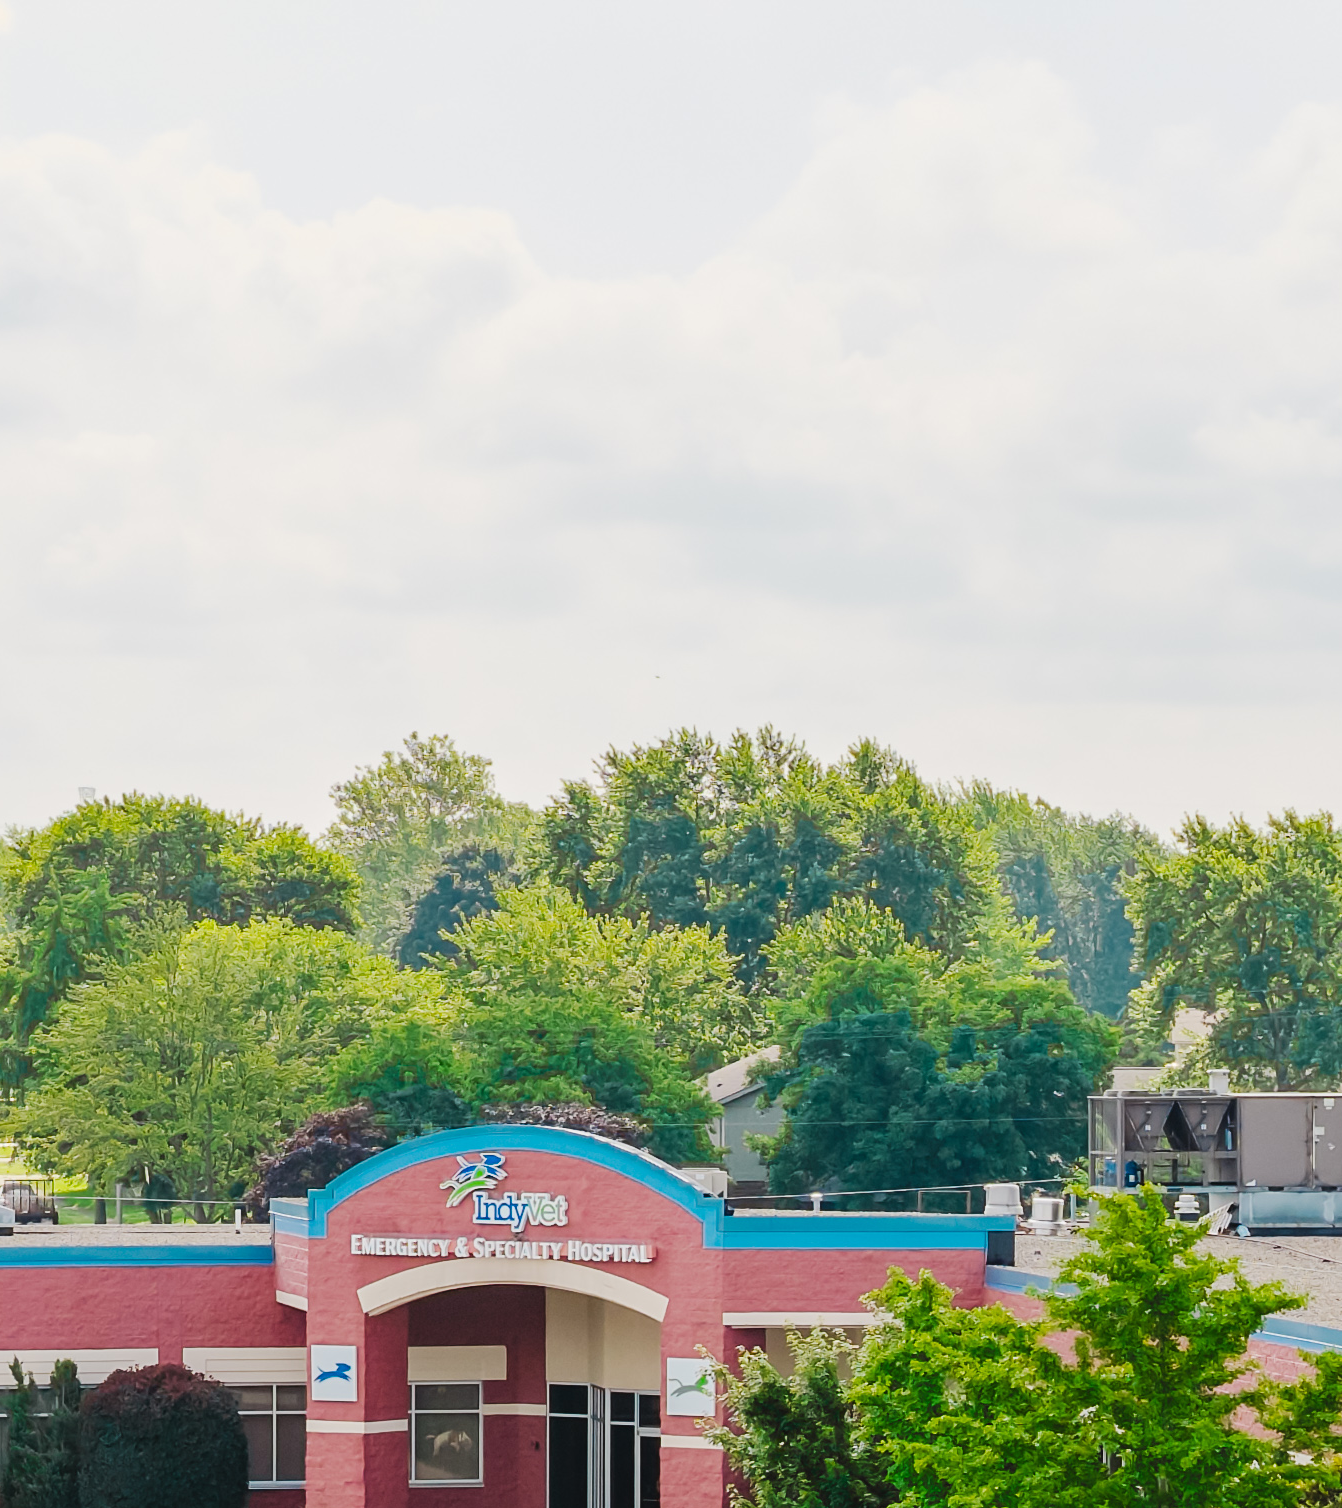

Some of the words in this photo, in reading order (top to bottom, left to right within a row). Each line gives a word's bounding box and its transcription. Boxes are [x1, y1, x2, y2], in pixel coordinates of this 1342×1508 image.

[474, 1193, 567, 1230] IndyVet
[351, 1234, 451, 1257] EMERGENCY
[455, 1237, 469, 1258] &
[473, 1237, 563, 1260] SPECIALTY
[568, 1240, 653, 1263] HOSPITAL
